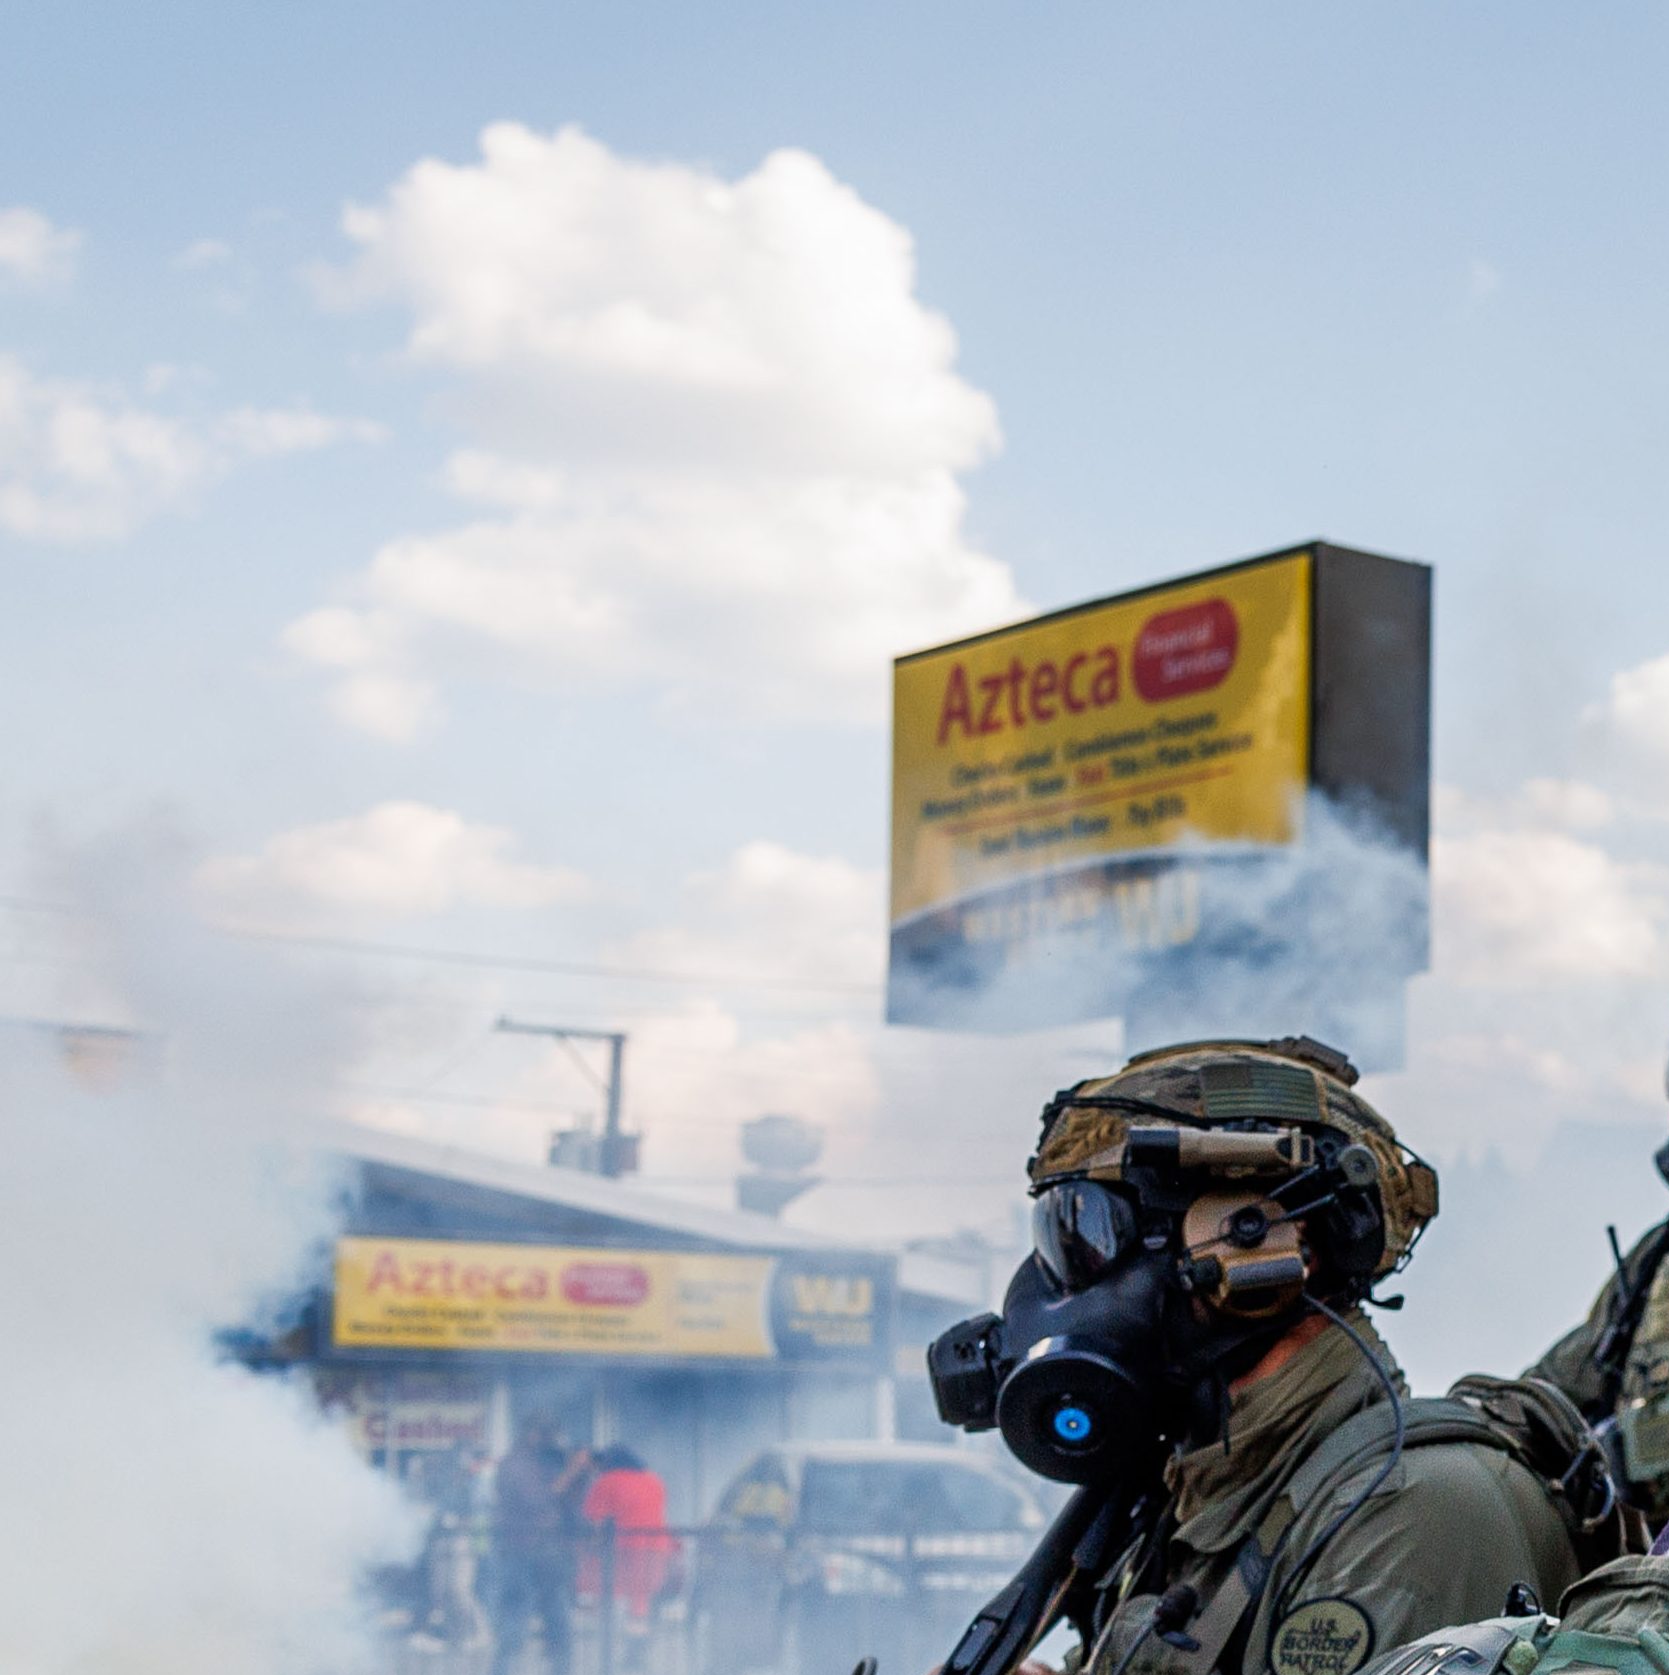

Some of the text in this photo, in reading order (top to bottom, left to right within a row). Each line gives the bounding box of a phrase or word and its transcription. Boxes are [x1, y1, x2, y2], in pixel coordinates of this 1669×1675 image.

[937, 645, 1122, 748] Azteca
[366, 1251, 549, 1301] Azteca
[1283, 1634, 1354, 1651] BORDER
[1281, 1652, 1346, 1671] PATROL
